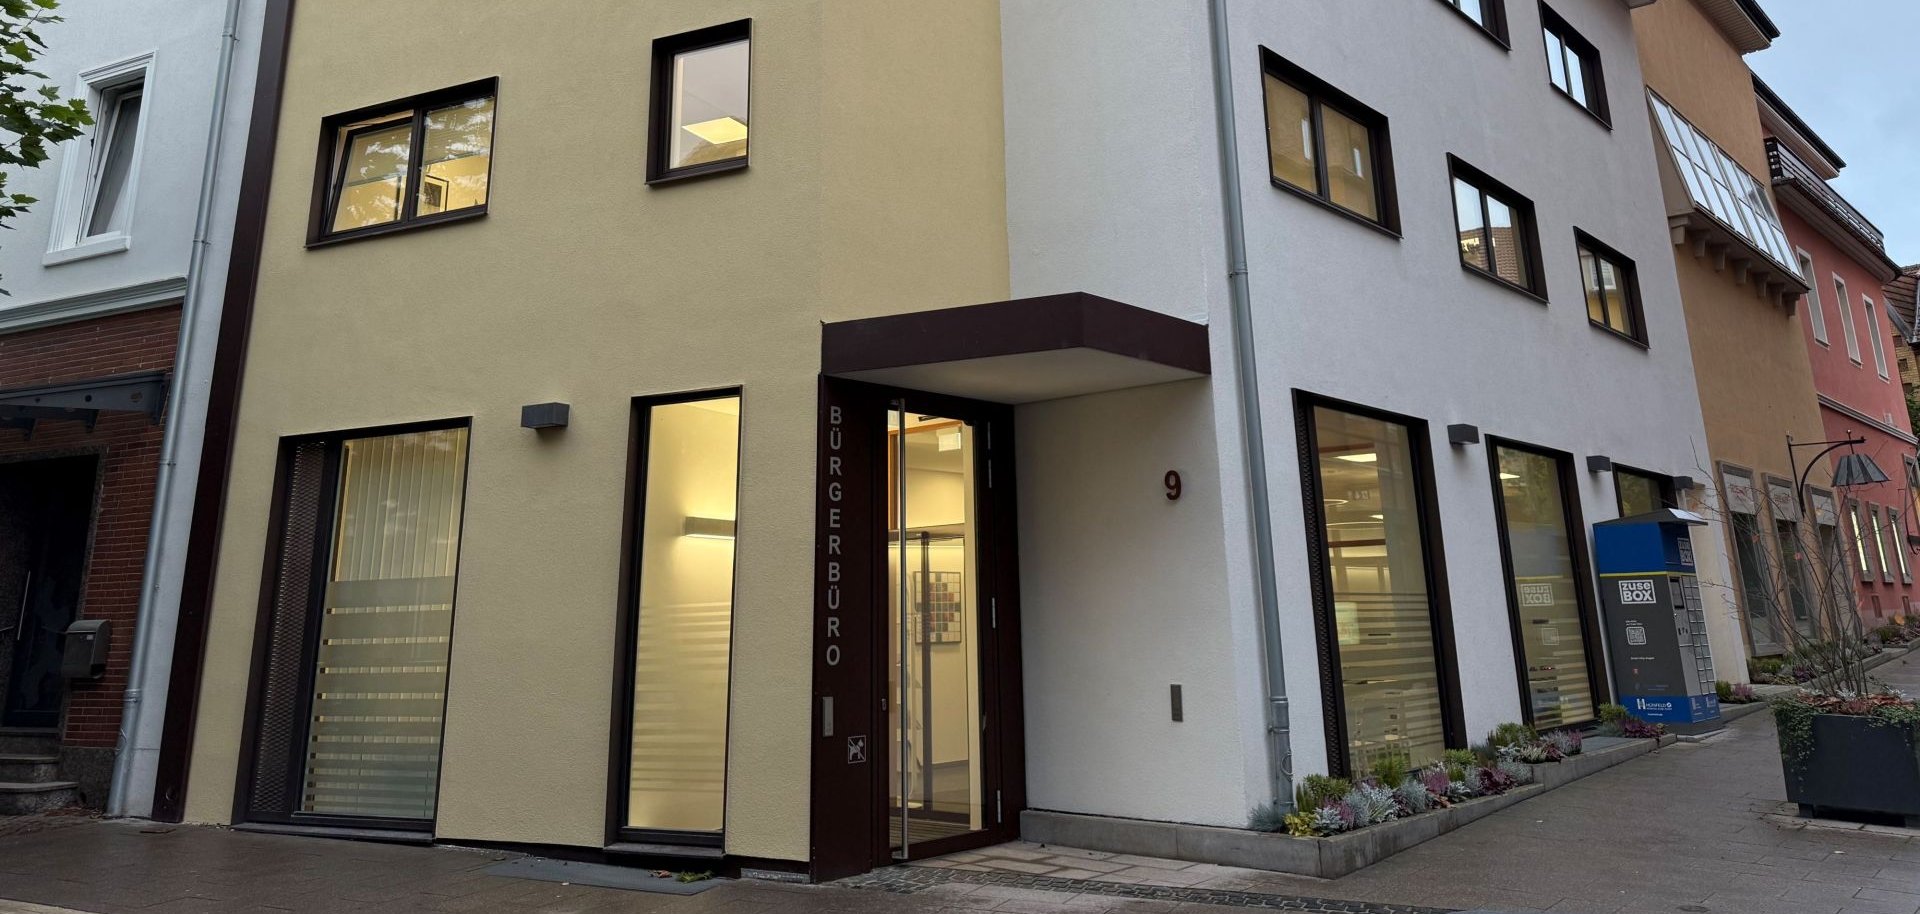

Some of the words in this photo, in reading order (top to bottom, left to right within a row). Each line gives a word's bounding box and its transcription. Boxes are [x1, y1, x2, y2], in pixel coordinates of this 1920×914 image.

[1164, 470, 1182, 500] 9
[826, 405, 842, 666] BÜRGERBÜRO
[1622, 582, 1651, 591] zuse
[1623, 590, 1653, 602] BOX
